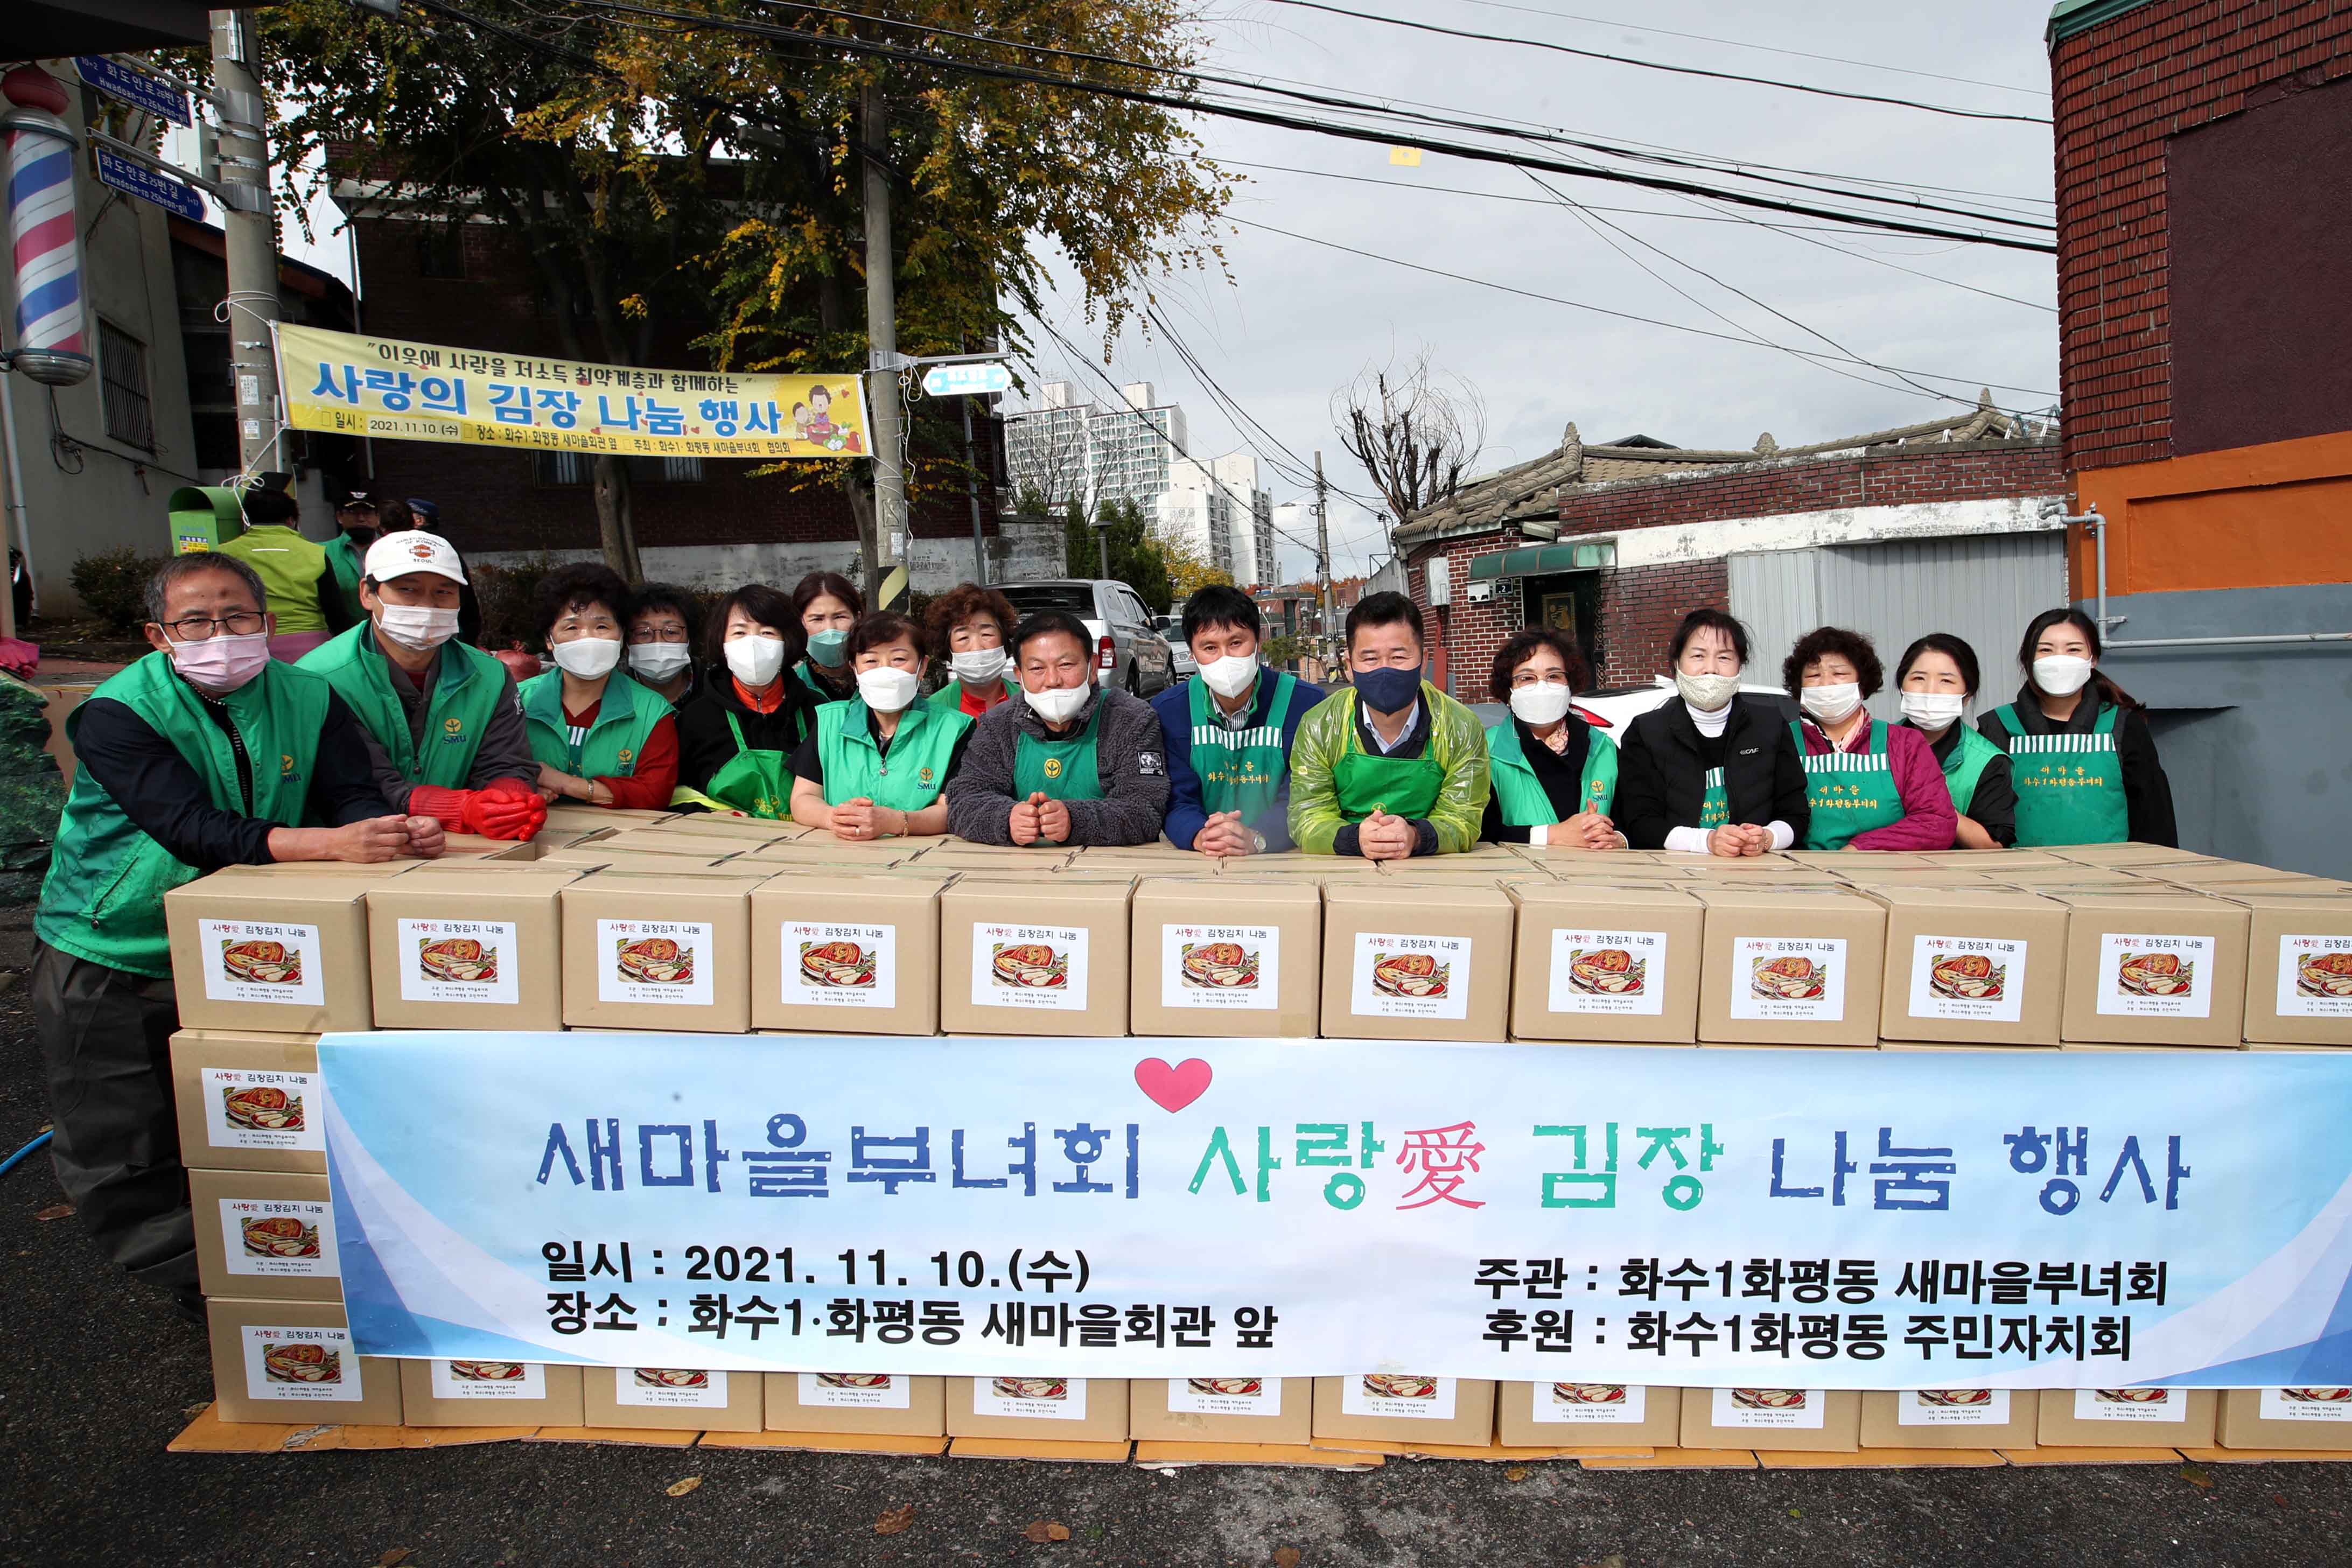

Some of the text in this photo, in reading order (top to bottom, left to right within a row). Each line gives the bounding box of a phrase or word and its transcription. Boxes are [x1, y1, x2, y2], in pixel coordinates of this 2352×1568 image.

[449, 353, 507, 377] 사랑을
[514, 360, 568, 383] 저소득
[311, 362, 467, 415] 사랑의
[488, 383, 582, 429] 김장
[598, 395, 685, 436] 나눔
[698, 398, 782, 437] 행사
[335, 411, 356, 430] 일시
[477, 424, 495, 441] 장소
[563, 436, 606, 450] 새마을회관
[634, 439, 651, 452] 주최
[767, 442, 791, 454] 협의회
[443, 733, 467, 745] SMU
[617, 764, 634, 772] SMU
[1592, 794, 1608, 802] SMU
[246, 926, 283, 936] 김장김치
[288, 928, 306, 937] 나눔
[444, 924, 480, 933] 김장김치
[486, 926, 504, 934] 나눔
[641, 925, 677, 934] 김장김치
[683, 926, 701, 935] 나눔
[825, 927, 860, 937] 김장김치
[866, 929, 883, 938] 나눔
[1018, 929, 1053, 939] 김장김치
[1060, 931, 1077, 940] 나눔
[1208, 929, 1243, 939] 김장김치
[1249, 930, 1267, 939] 나눔
[1400, 939, 1436, 948] 김장김치
[1441, 941, 1459, 950] 나눔
[1597, 935, 1632, 944] 김장김치
[1637, 937, 1654, 946] 나눔
[2145, 939, 2180, 948] 김장김치
[2186, 940, 2202, 949] 나눔
[2325, 939, 2352, 948] 김장김
[1777, 942, 1812, 951] 김장김치
[1818, 943, 1835, 951] 나눔
[1958, 941, 1993, 951] 김장김치
[1998, 943, 2015, 952] 나눔
[247, 1073, 284, 1083] 김장김치
[290, 1076, 307, 1084] 나눔
[536, 1112, 1139, 1199] 새마을부녀회
[1532, 1122, 1724, 1212] 김장
[1769, 1126, 1957, 1211] 나눔
[2003, 1125, 2192, 1216] 행사
[263, 1203, 301, 1213] 김장김치
[541, 1241, 634, 1283] 일시
[1474, 1257, 1569, 1300] 주관
[1618, 1257, 1879, 1305] 화수1화평동
[1895, 1259, 2168, 1306] 새마을부녀회
[545, 1291, 638, 1335] 장소
[981, 1301, 1216, 1348] 새마을회관
[1234, 1305, 1279, 1348] 앞
[286, 1331, 323, 1339] 김장김치
[1482, 1308, 1574, 1353] 후원
[1627, 1310, 1888, 1361] 화수1화평동
[1903, 1314, 2131, 1362] 주민자치회
